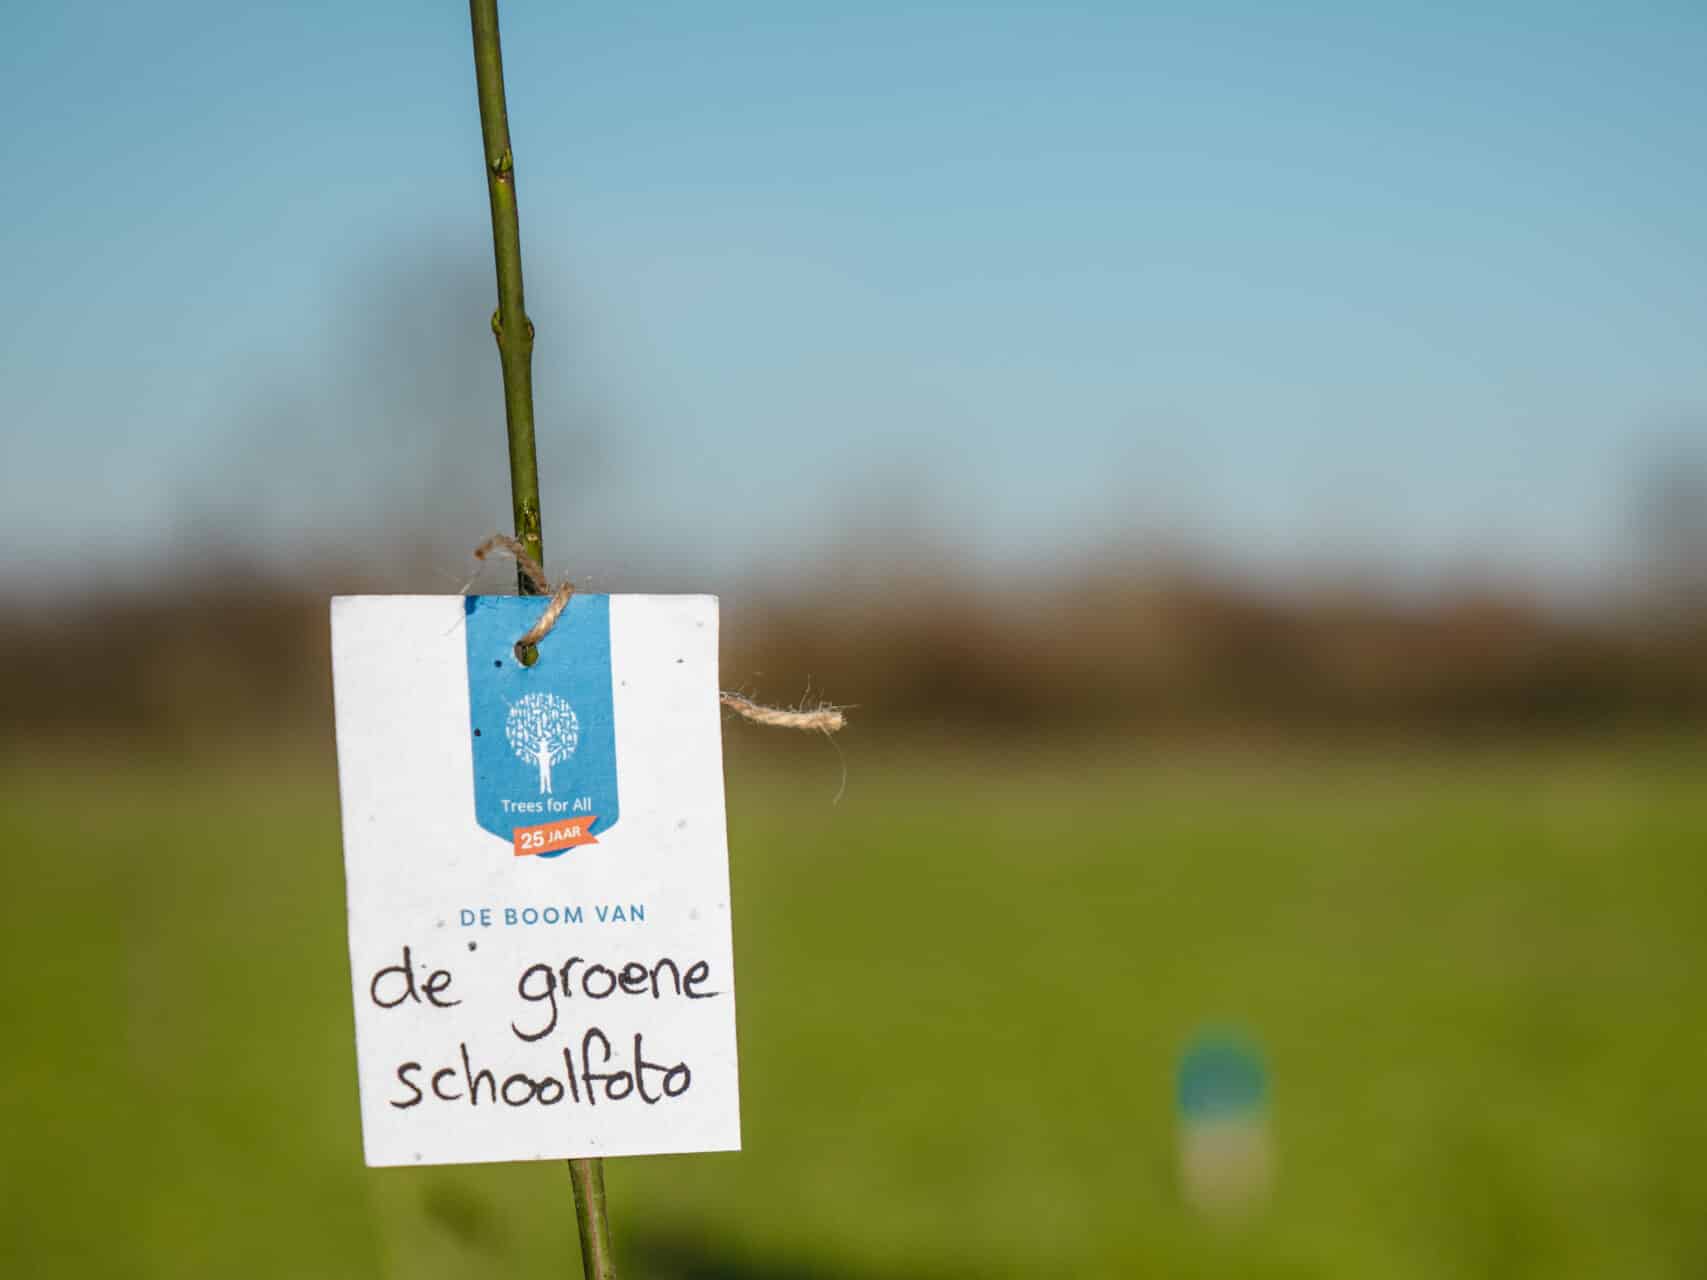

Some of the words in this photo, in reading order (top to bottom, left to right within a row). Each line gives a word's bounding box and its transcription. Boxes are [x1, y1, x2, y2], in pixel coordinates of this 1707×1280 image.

[501, 798, 544, 814] Trees
[547, 797, 569, 812] for
[572, 796, 592, 812] All
[520, 831, 545, 850] 25
[547, 825, 582, 844] JAAR
[460, 908, 492, 927] DE
[504, 904, 584, 926] BOOM
[595, 903, 646, 923] VAN
[370, 945, 462, 1009] de
[511, 956, 720, 1042] groene
[390, 1026, 692, 1109] schoolfoto
